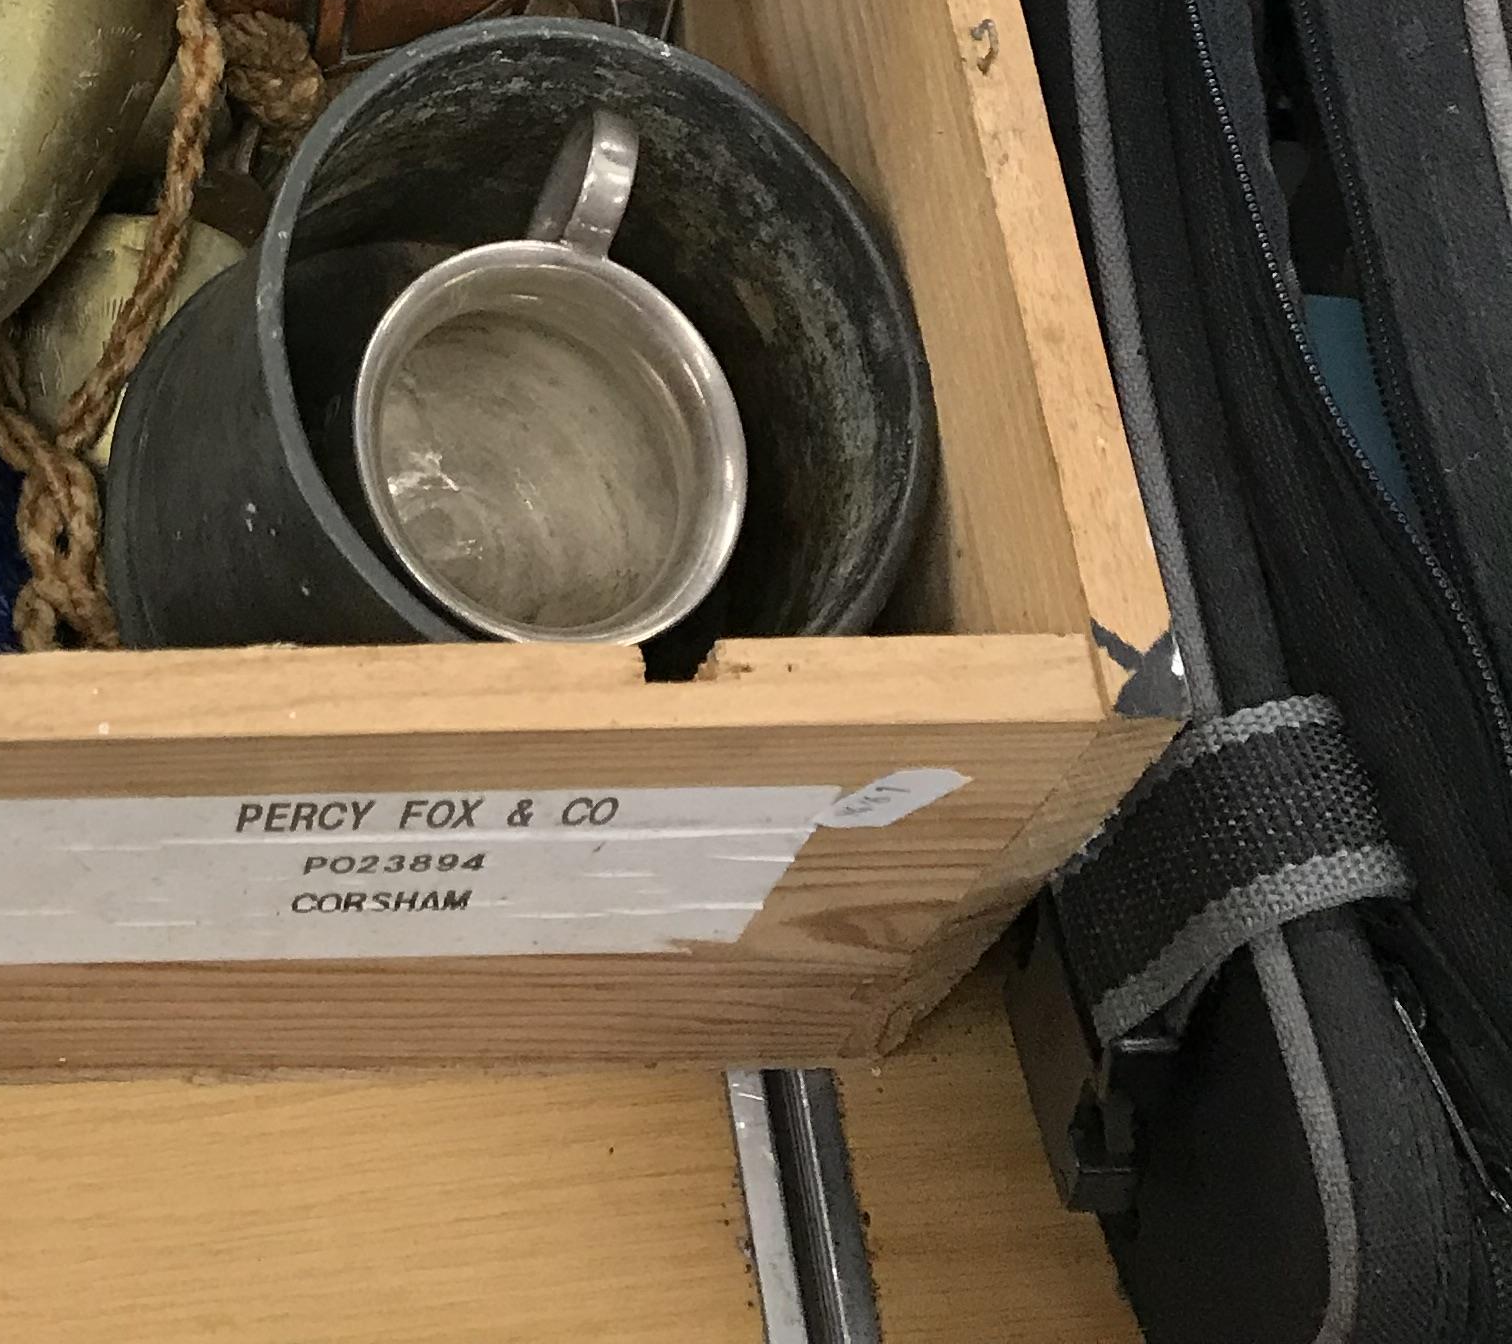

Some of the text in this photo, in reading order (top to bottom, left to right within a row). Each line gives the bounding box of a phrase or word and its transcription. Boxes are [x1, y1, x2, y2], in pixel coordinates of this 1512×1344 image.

[235, 796, 621, 833] PERCY FOX & CO
[302, 851, 487, 876] PO23894
[291, 889, 474, 914] CORSHAM
